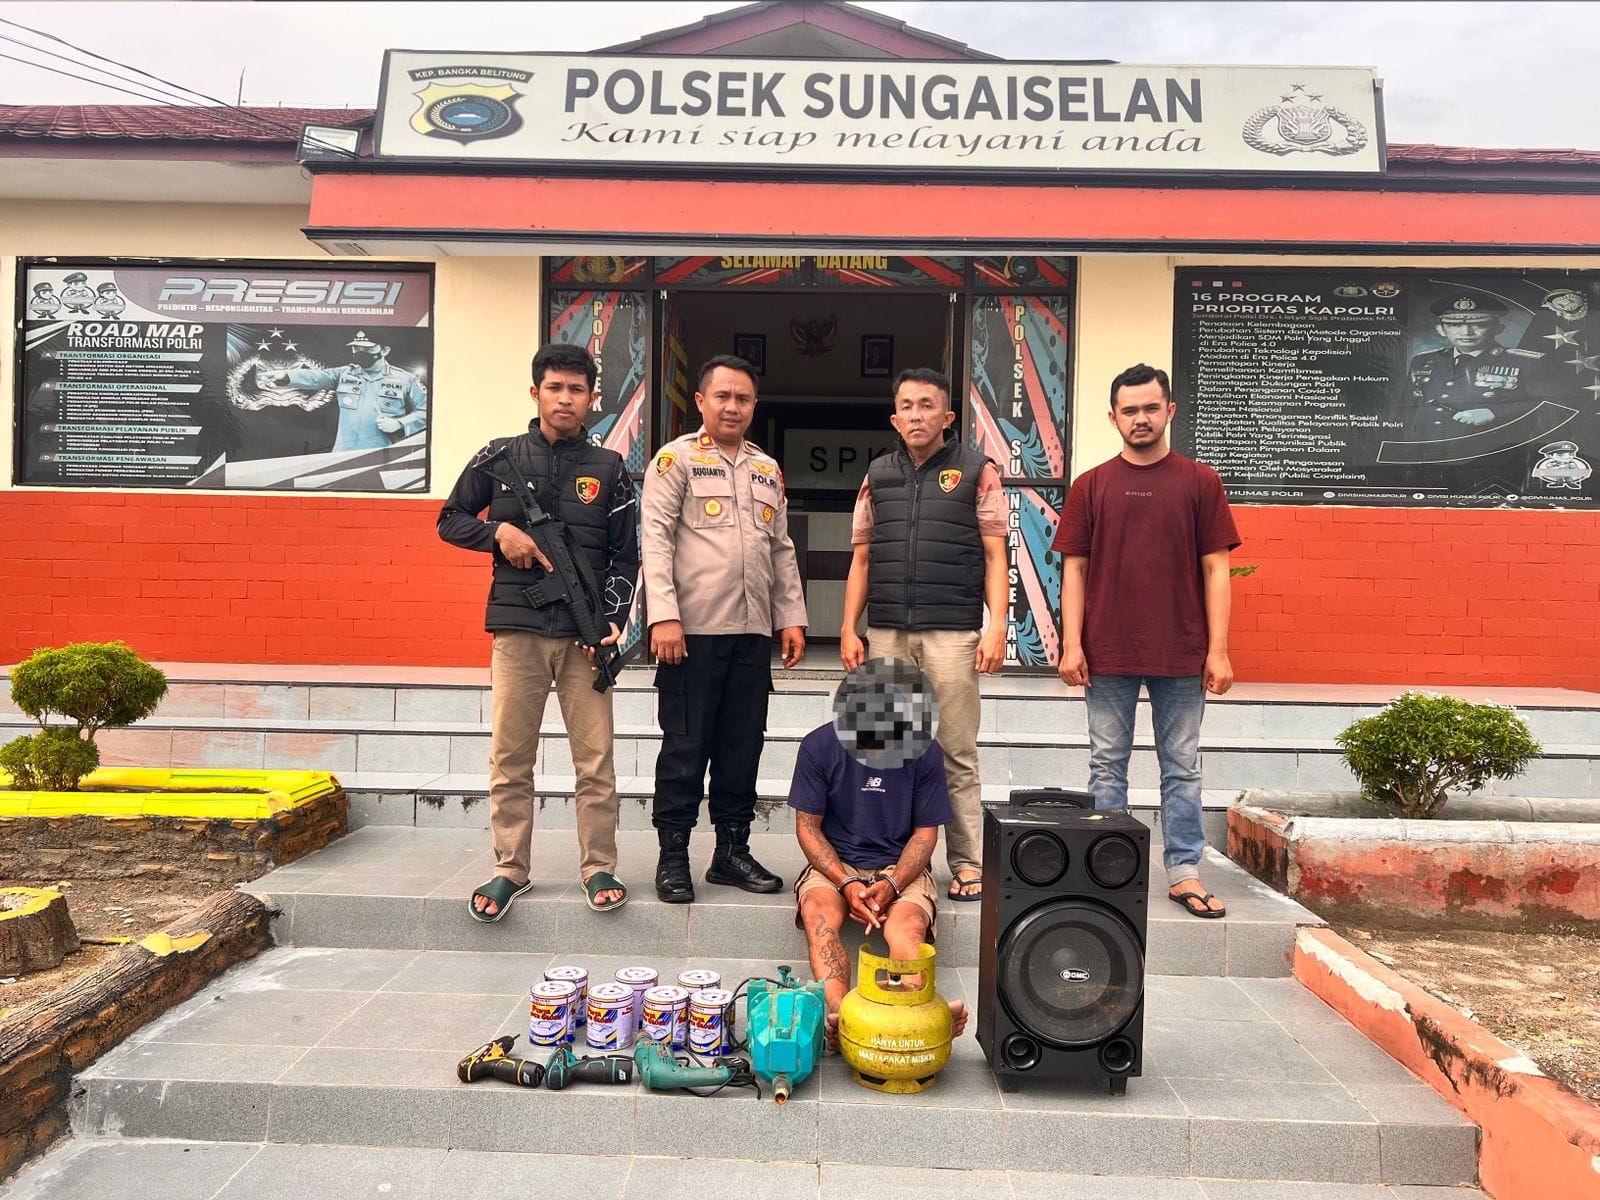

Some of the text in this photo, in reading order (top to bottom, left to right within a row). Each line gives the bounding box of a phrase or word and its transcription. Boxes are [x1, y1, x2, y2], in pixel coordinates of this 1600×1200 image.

[415, 68, 527, 81] KEP. BANGKA BELITUNG
[564, 68, 1203, 123] POLSEK SUNGAISELAN
[561, 122, 1207, 157] Kami siap melayani anda
[159, 278, 404, 306] PRESISI
[1192, 293, 1321, 303] 16 PROGRAM
[158, 304, 198, 312] PREDIKTIF
[205, 305, 273, 313] RESPONSIBILITAS
[281, 306, 340, 315] TRANSPARANSI
[1192, 304, 1394, 315] PRIORITAS KAPOLRI
[67, 323, 204, 338] ROAD MAP
[67, 336, 202, 349] TRANSFORMASI POLRI
[1012, 305, 1025, 418] POLSEK
[1198, 373, 1256, 381] Peningkatan
[1196, 412, 1248, 420] Penguatan
[1250, 413, 1311, 421] Penanganan
[1196, 419, 1255, 427] Peningkatan
[1261, 426, 1311, 434] Pelayanan
[1196, 438, 1257, 446] Pemantapan
[1249, 459, 1280, 467] Fungsi
[1283, 460, 1345, 468] Pengawasan
[692, 467, 726, 478] SUGIANTO
[1286, 466, 1342, 474] Masyarakat
[751, 473, 777, 489] POLRI
[1279, 472, 1310, 480] (Public
[871, 1036, 925, 1048] HANYA UNTUK
